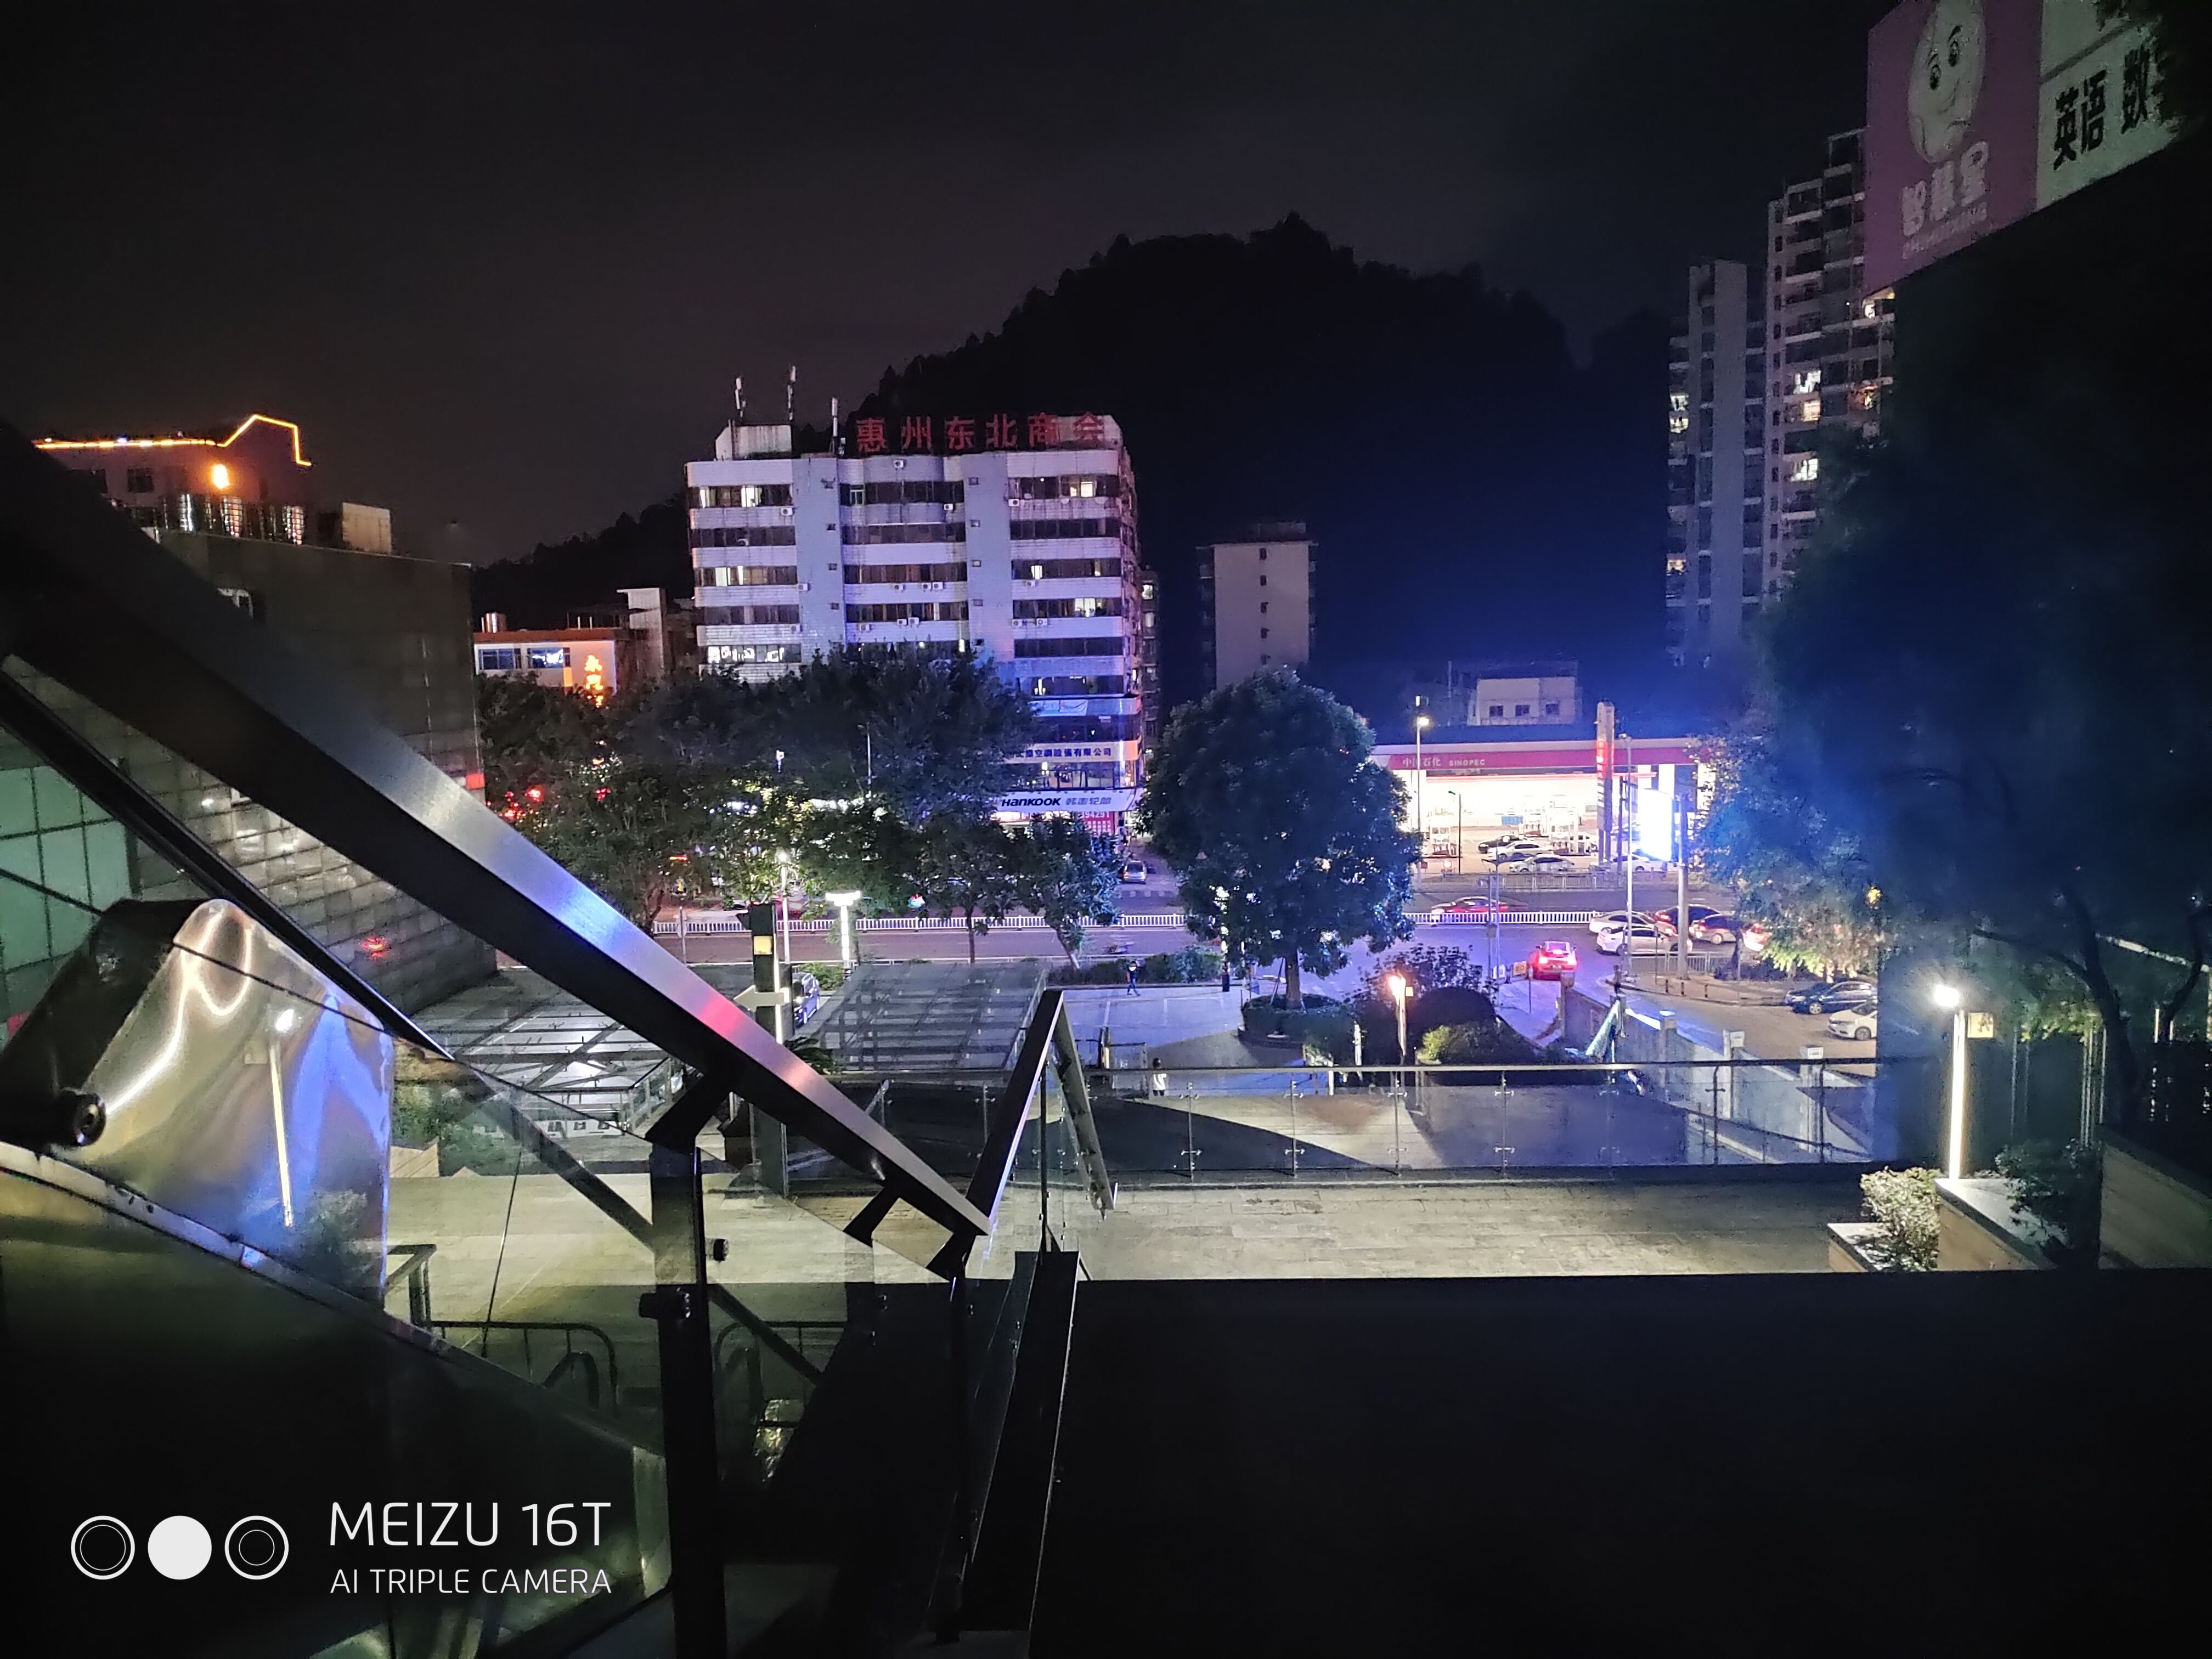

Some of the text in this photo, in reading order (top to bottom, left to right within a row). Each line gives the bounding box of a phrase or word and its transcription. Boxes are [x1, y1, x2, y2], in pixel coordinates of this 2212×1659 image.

[2053, 69, 2107, 171] 英语
[856, 412, 1104, 453] 惠州东北商会
[1402, 757, 1441, 767] 中石化
